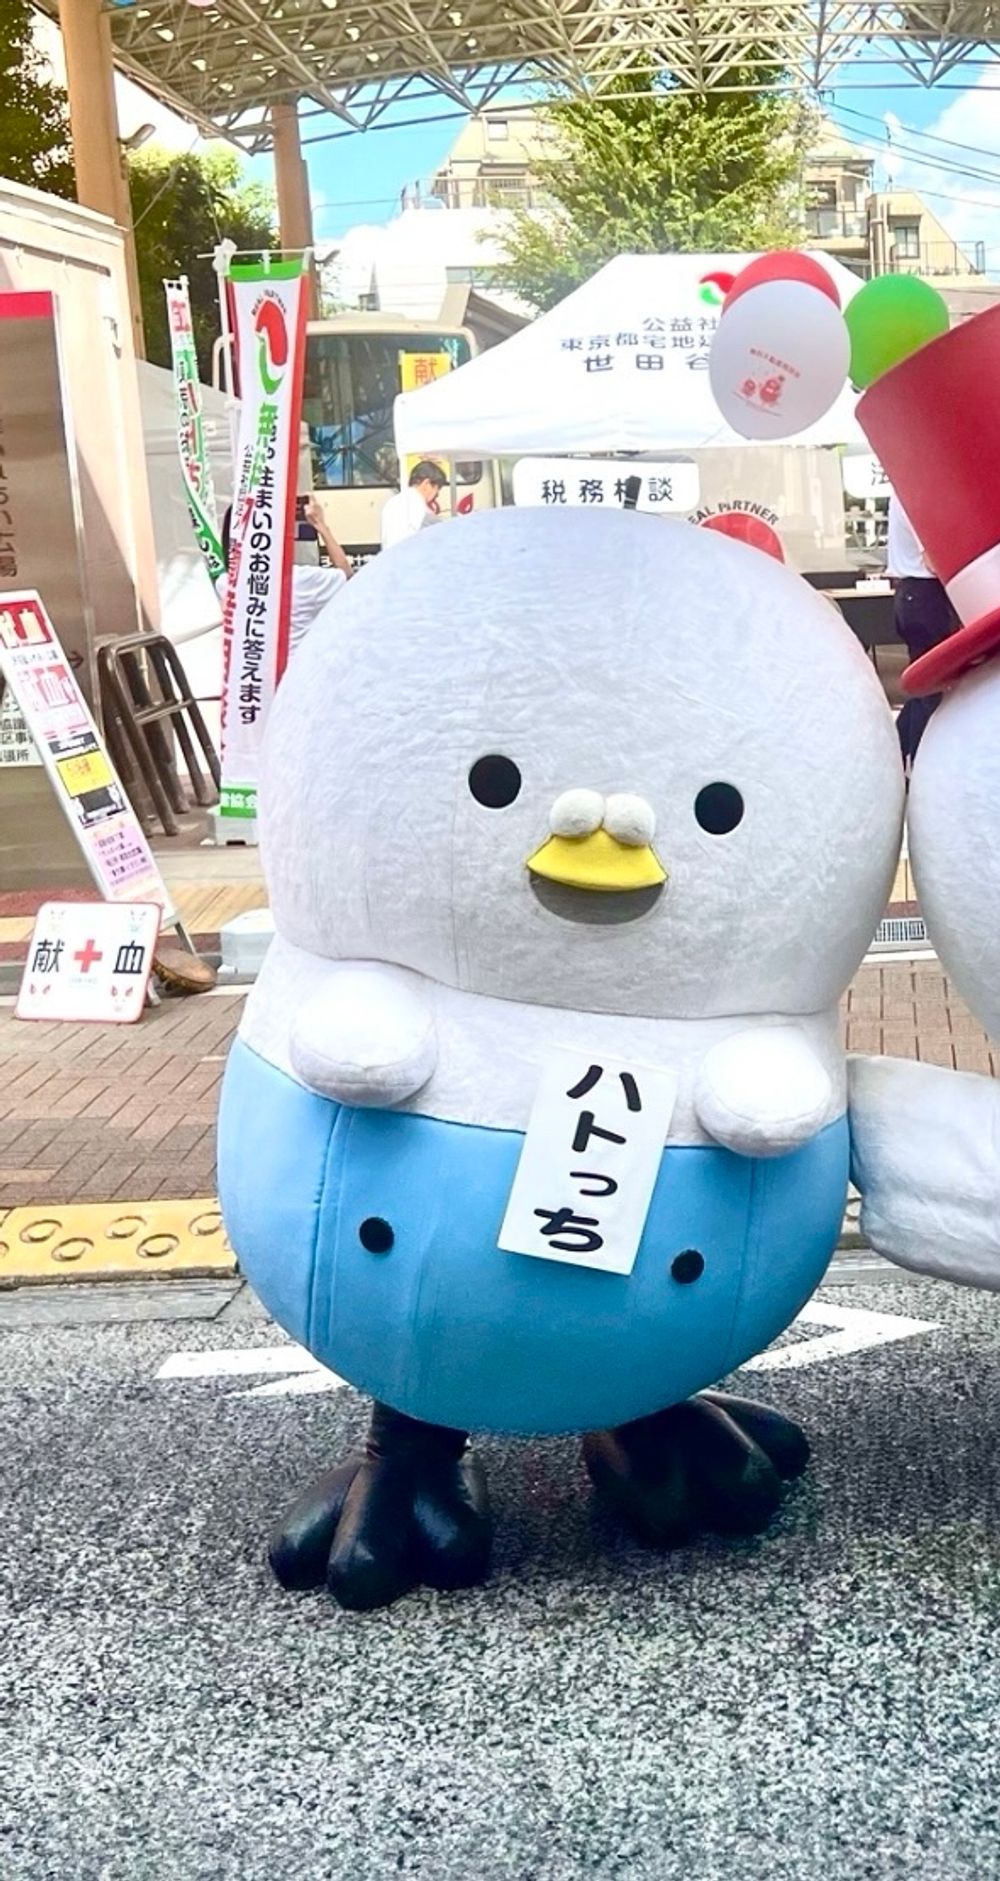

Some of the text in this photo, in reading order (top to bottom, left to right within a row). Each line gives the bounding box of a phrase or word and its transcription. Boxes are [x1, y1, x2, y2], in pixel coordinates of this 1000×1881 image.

[31, 938, 146, 975] 献 血
[533, 1064, 642, 1253] ハトっち
